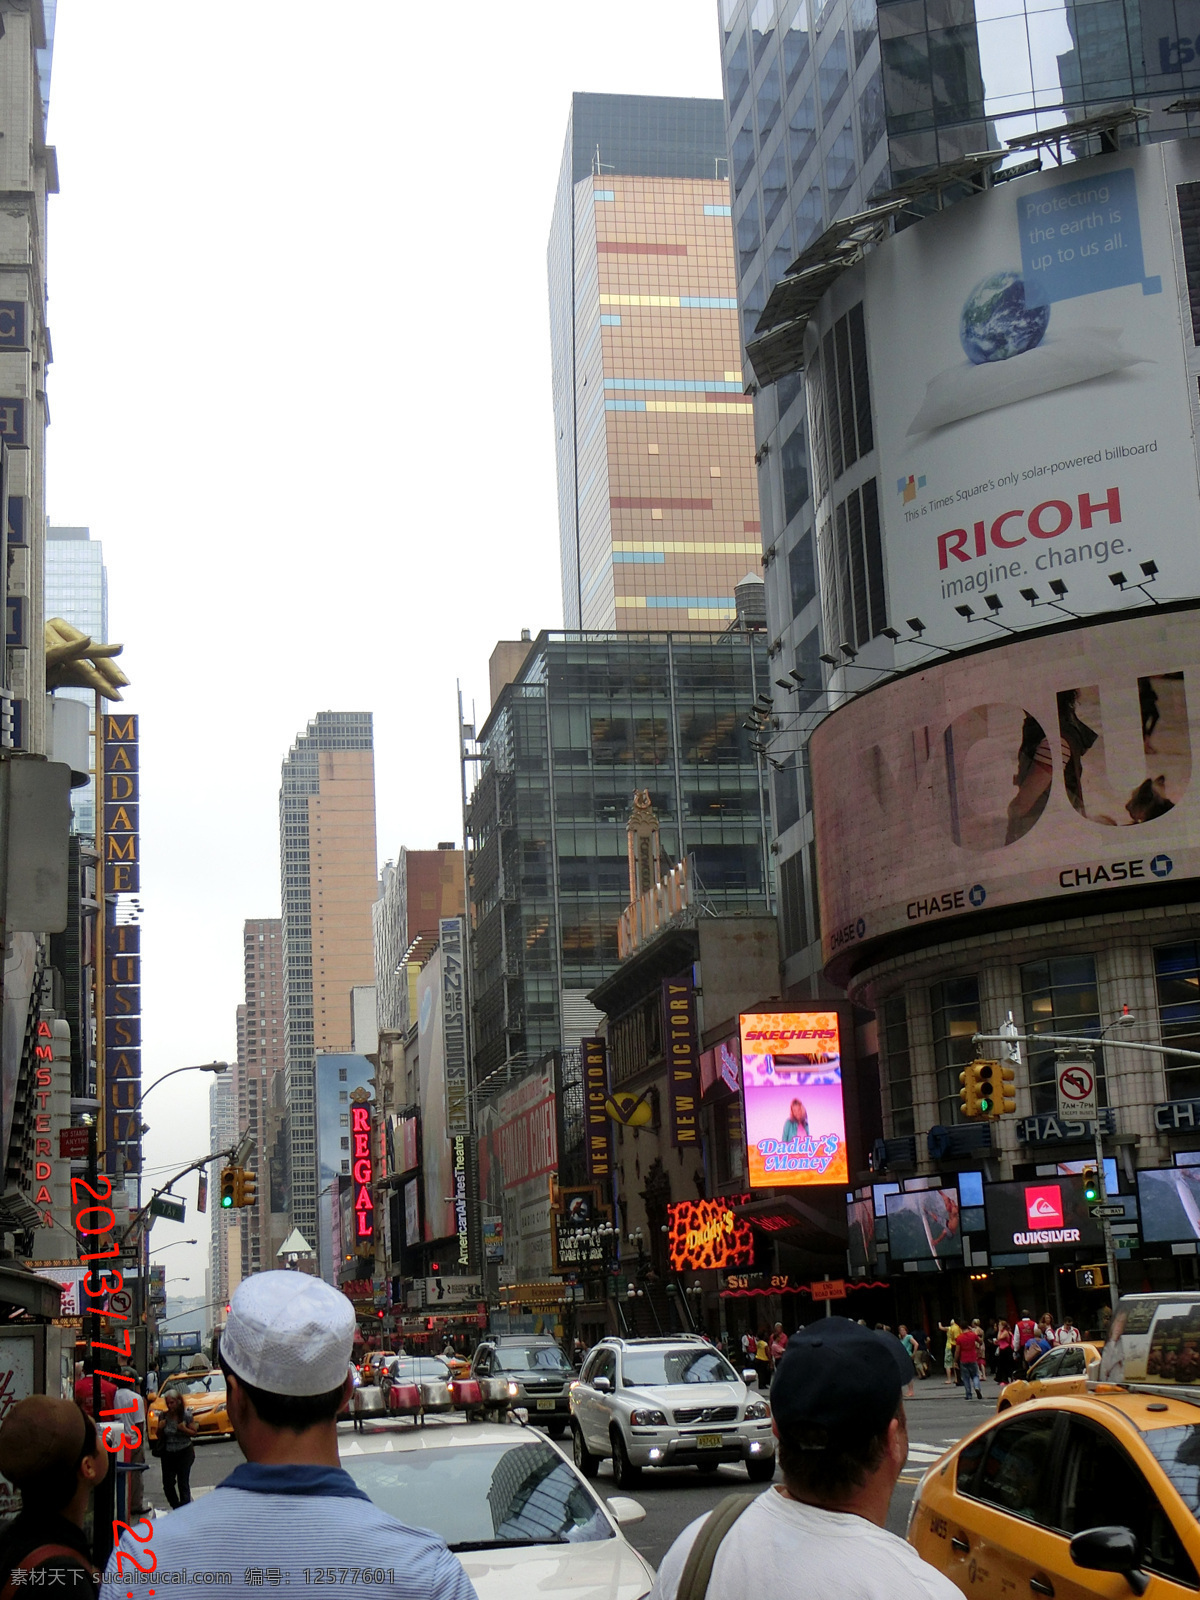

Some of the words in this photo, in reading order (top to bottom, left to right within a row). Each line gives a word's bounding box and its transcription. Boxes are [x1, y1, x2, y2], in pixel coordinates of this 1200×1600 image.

[1026, 187, 1110, 219] Protecting
[1029, 228, 1055, 244] the
[1060, 212, 1104, 236] earth
[1109, 208, 1122, 223] is
[1032, 254, 1053, 271] up
[1057, 247, 1075, 263] to
[1080, 242, 1099, 257] us
[1104, 232, 1128, 252] all.
[904, 511, 920, 523] This
[921, 505, 928, 516] is
[929, 496, 954, 513] Times
[956, 479, 995, 505] Square's
[997, 472, 1019, 488] only
[1022, 450, 1103, 481] solar-powered
[1105, 440, 1158, 461] billboard
[937, 487, 1122, 571] RICOH
[941, 561, 1028, 600] imagine.
[1035, 538, 1133, 571] change.
[107, 716, 137, 891] MADAME
[1059, 859, 1145, 888] CHASE
[906, 890, 964, 920] CHASE
[442, 921, 461, 954] NEW
[830, 925, 856, 951] CHASE
[443, 955, 462, 992] 42
[445, 1014, 465, 1078] STUDIOS
[669, 985, 692, 1081] VICTORY
[744, 1029, 837, 1041] SKECHERS
[587, 1043, 606, 1123] VICTORY
[448, 1086, 466, 1124] DUKE
[675, 1096, 696, 1142] NEW
[1061, 1101, 1094, 1109] 7AM-7PM
[1153, 1102, 1200, 1132] CH
[35, 1021, 54, 1228] AMSTERDAM
[530, 1098, 558, 1172] COHEN
[352, 1108, 374, 1236] REGAL
[591, 1136, 608, 1174] NEW
[764, 1155, 833, 1174] Money
[1013, 1228, 1081, 1246] QUIKSILVER
